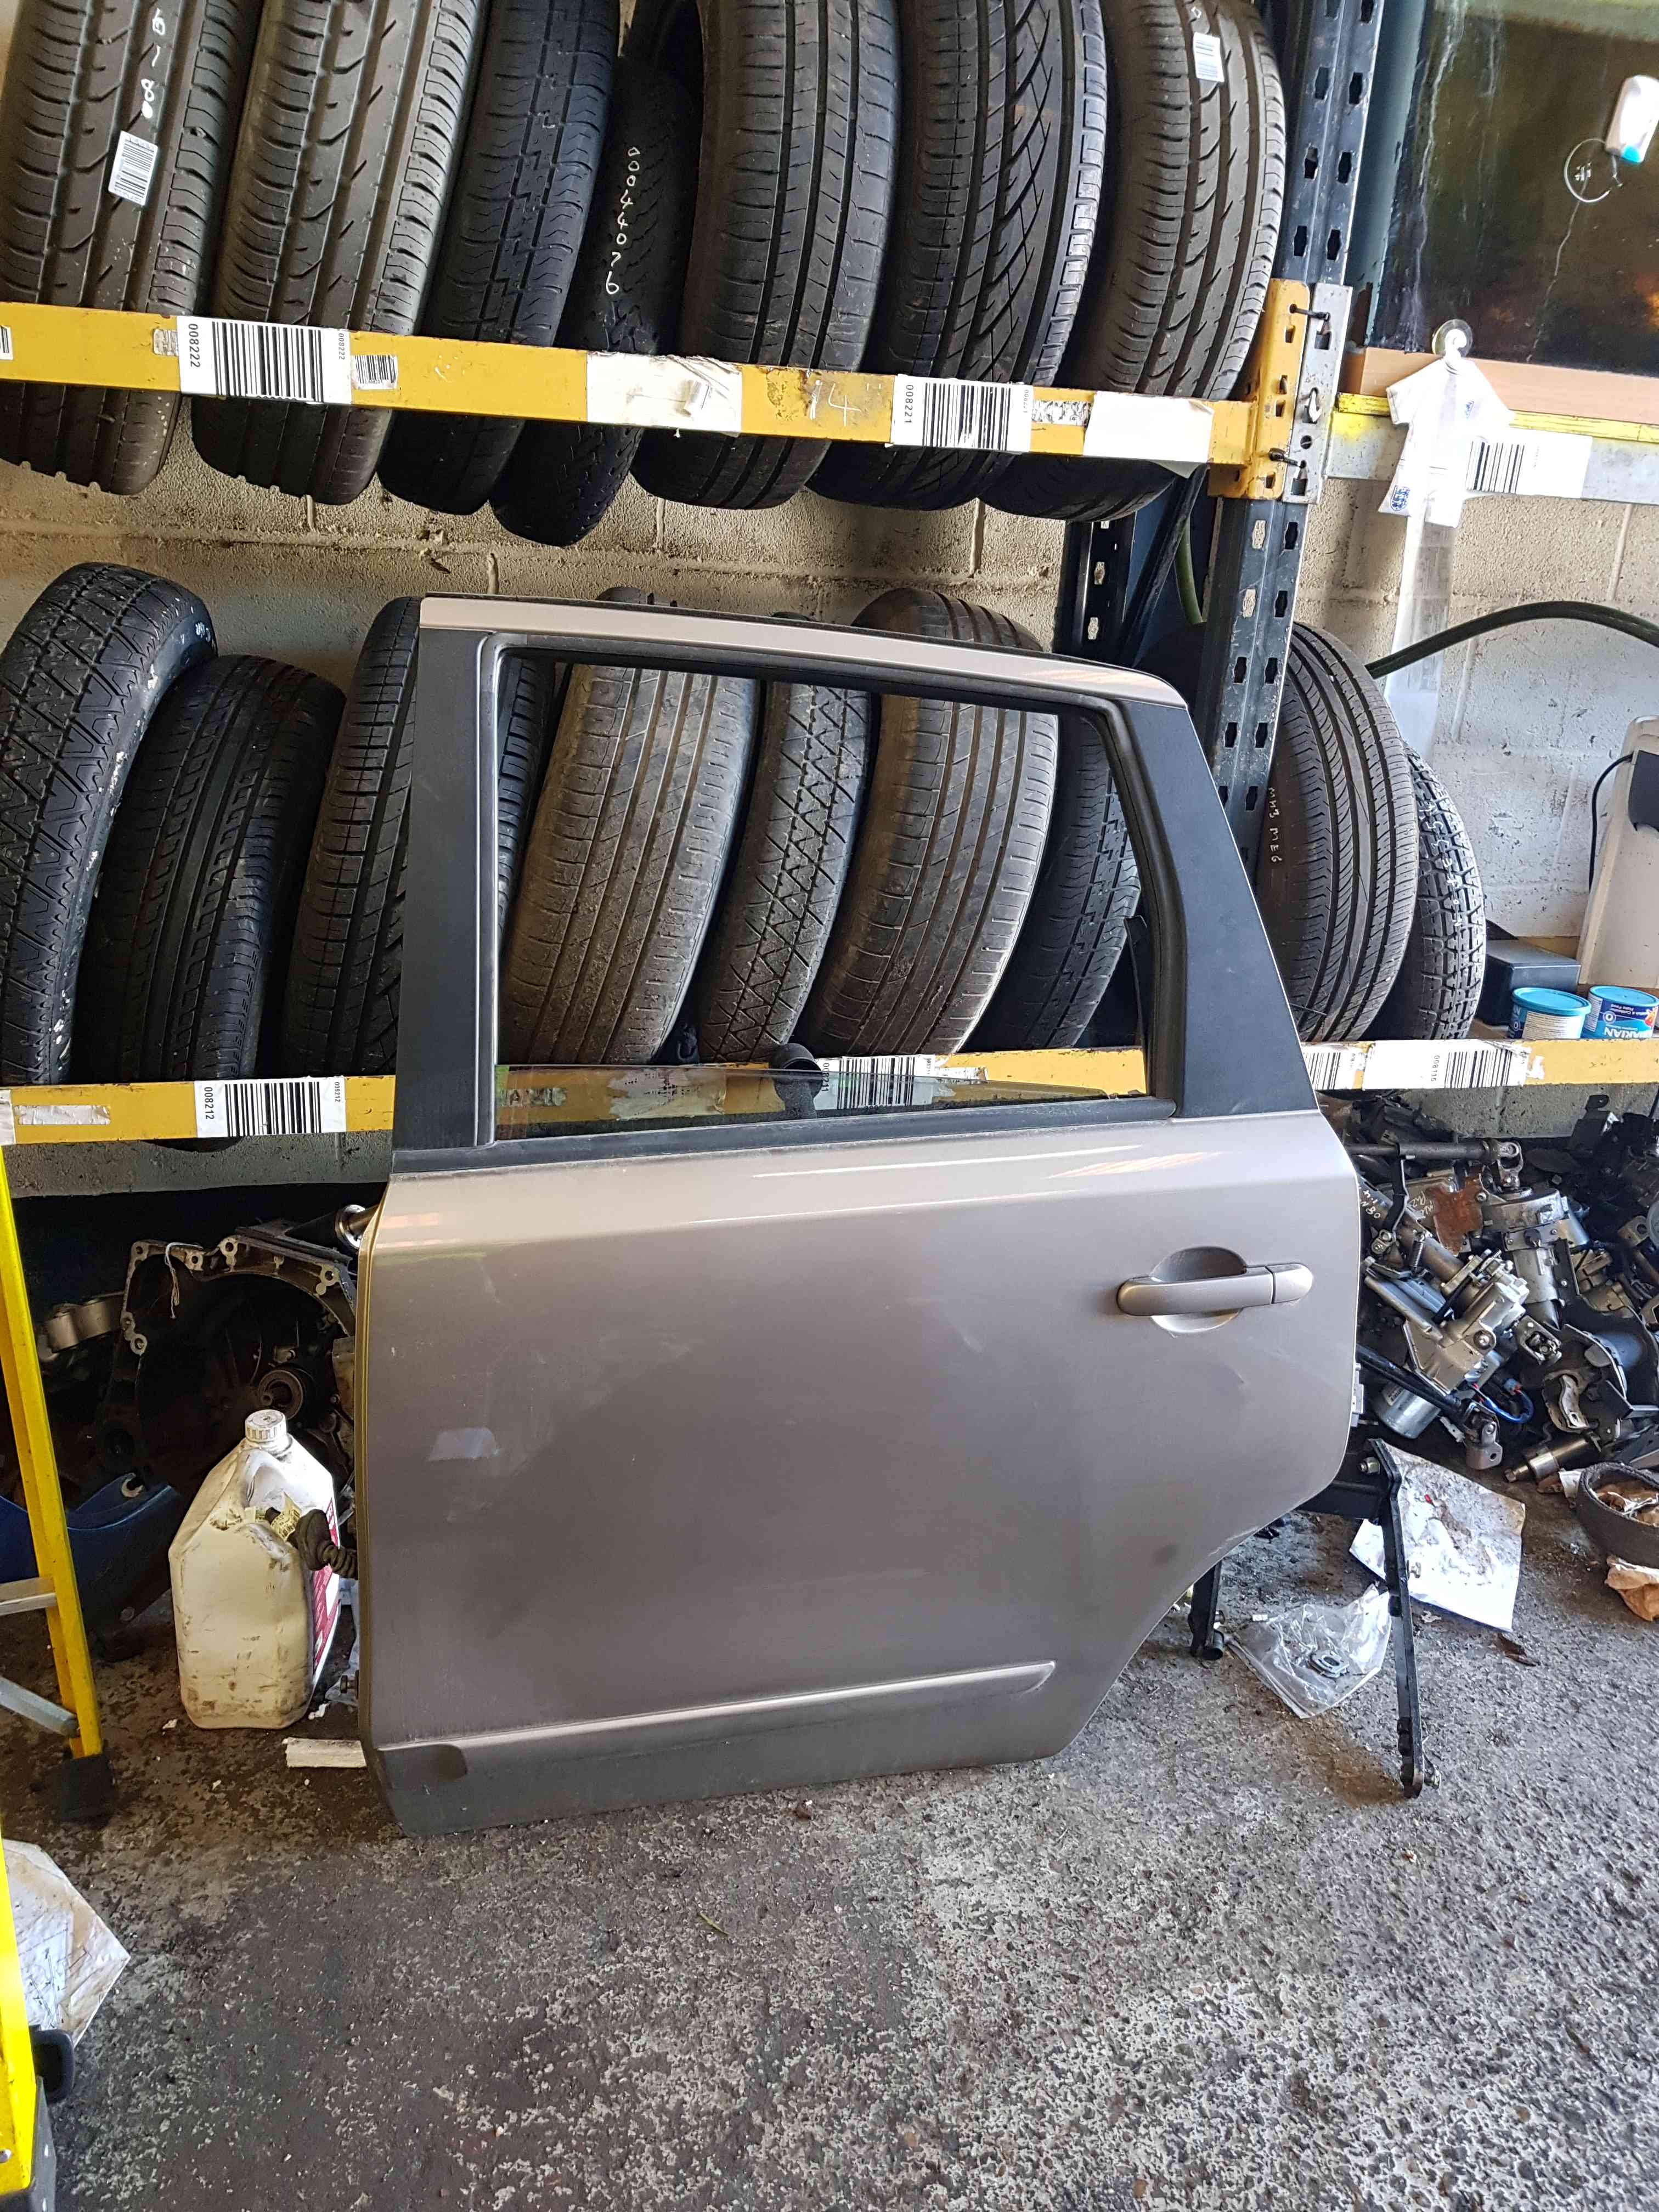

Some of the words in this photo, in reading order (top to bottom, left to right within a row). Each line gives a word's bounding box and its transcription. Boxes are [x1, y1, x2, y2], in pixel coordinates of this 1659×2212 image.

[605, 146, 641, 295] 00044076
[188, 323, 201, 368] 008222
[904, 384, 914, 424] 008221
[821, 1063, 830, 1092] 008211
[204, 1086, 215, 1120] 008212
